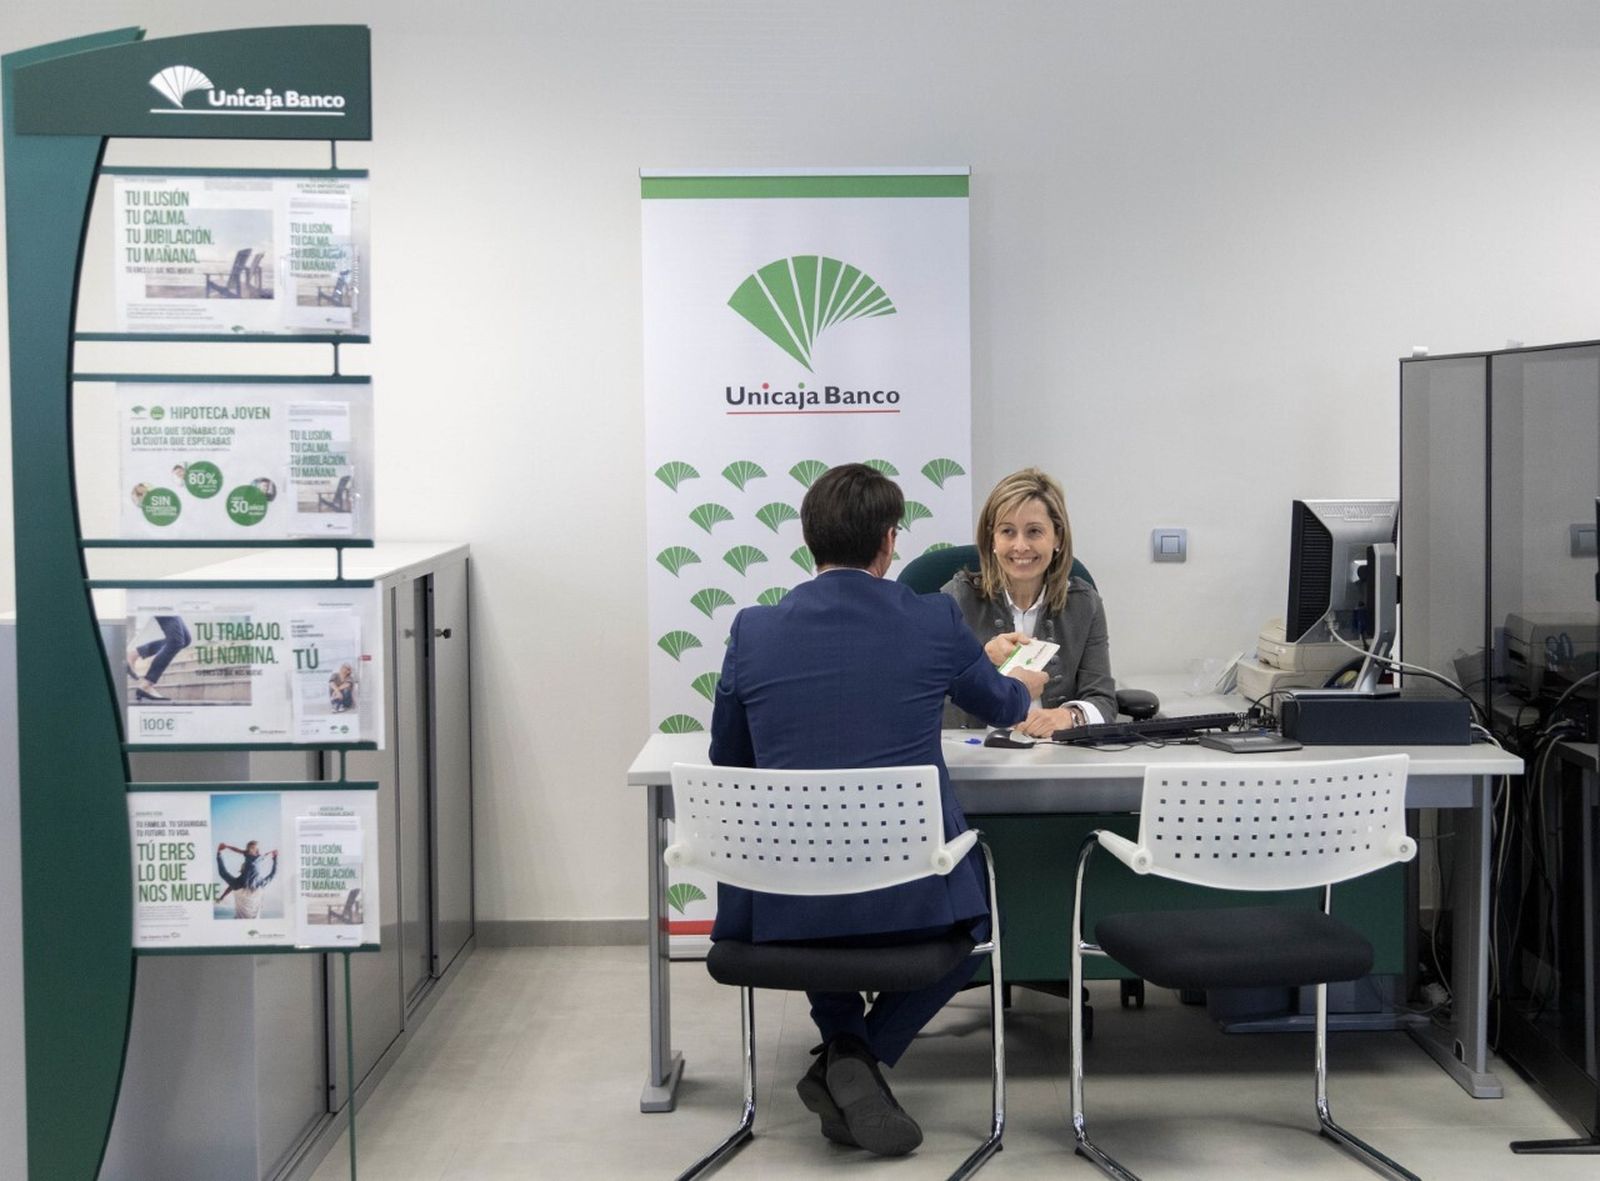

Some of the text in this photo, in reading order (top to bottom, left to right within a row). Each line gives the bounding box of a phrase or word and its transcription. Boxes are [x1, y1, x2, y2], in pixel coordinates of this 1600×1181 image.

[208, 87, 345, 111] Unicaja Banco
[125, 188, 190, 207] TU ILUSIÓN
[125, 209, 189, 226] TU CALMA.
[290, 222, 300, 234] TU
[125, 226, 215, 245] TU JUBILACIÓN.
[290, 235, 300, 247] TU
[125, 244, 200, 264] TU MAÑANA.
[290, 260, 300, 272] TU
[726, 382, 900, 410] Unicaja Banco
[170, 406, 271, 420] HIPOTECA JOVEN
[131, 424, 235, 436] LA CASA QUE SOÑABAS CON
[290, 429, 300, 440] TU
[131, 436, 231, 446] LA CUOTA QUE ESPERABAS
[290, 442, 300, 453] TU
[290, 455, 300, 465] TU
[290, 467, 300, 477] TU
[189, 472, 218, 486] 80%
[151, 496, 171, 506] SIN
[231, 501, 249, 514] 30
[195, 622, 213, 641] TU
[216, 622, 284, 641] TRABAJO.
[195, 642, 279, 664] TU NÓMINA.
[292, 643, 318, 670] TÚ
[143, 718, 175, 731] 100€
[136, 820, 143, 828] TU
[169, 820, 176, 828] TU
[136, 829, 143, 837] TU
[168, 829, 175, 837] TU
[136, 839, 195, 861] TÚ ERES
[300, 844, 311, 855] TU
[300, 856, 311, 867] TU
[138, 863, 187, 882] LO QUE
[300, 869, 311, 879] TU
[300, 881, 311, 891] TU
[138, 883, 221, 902] NOS MUEVE
